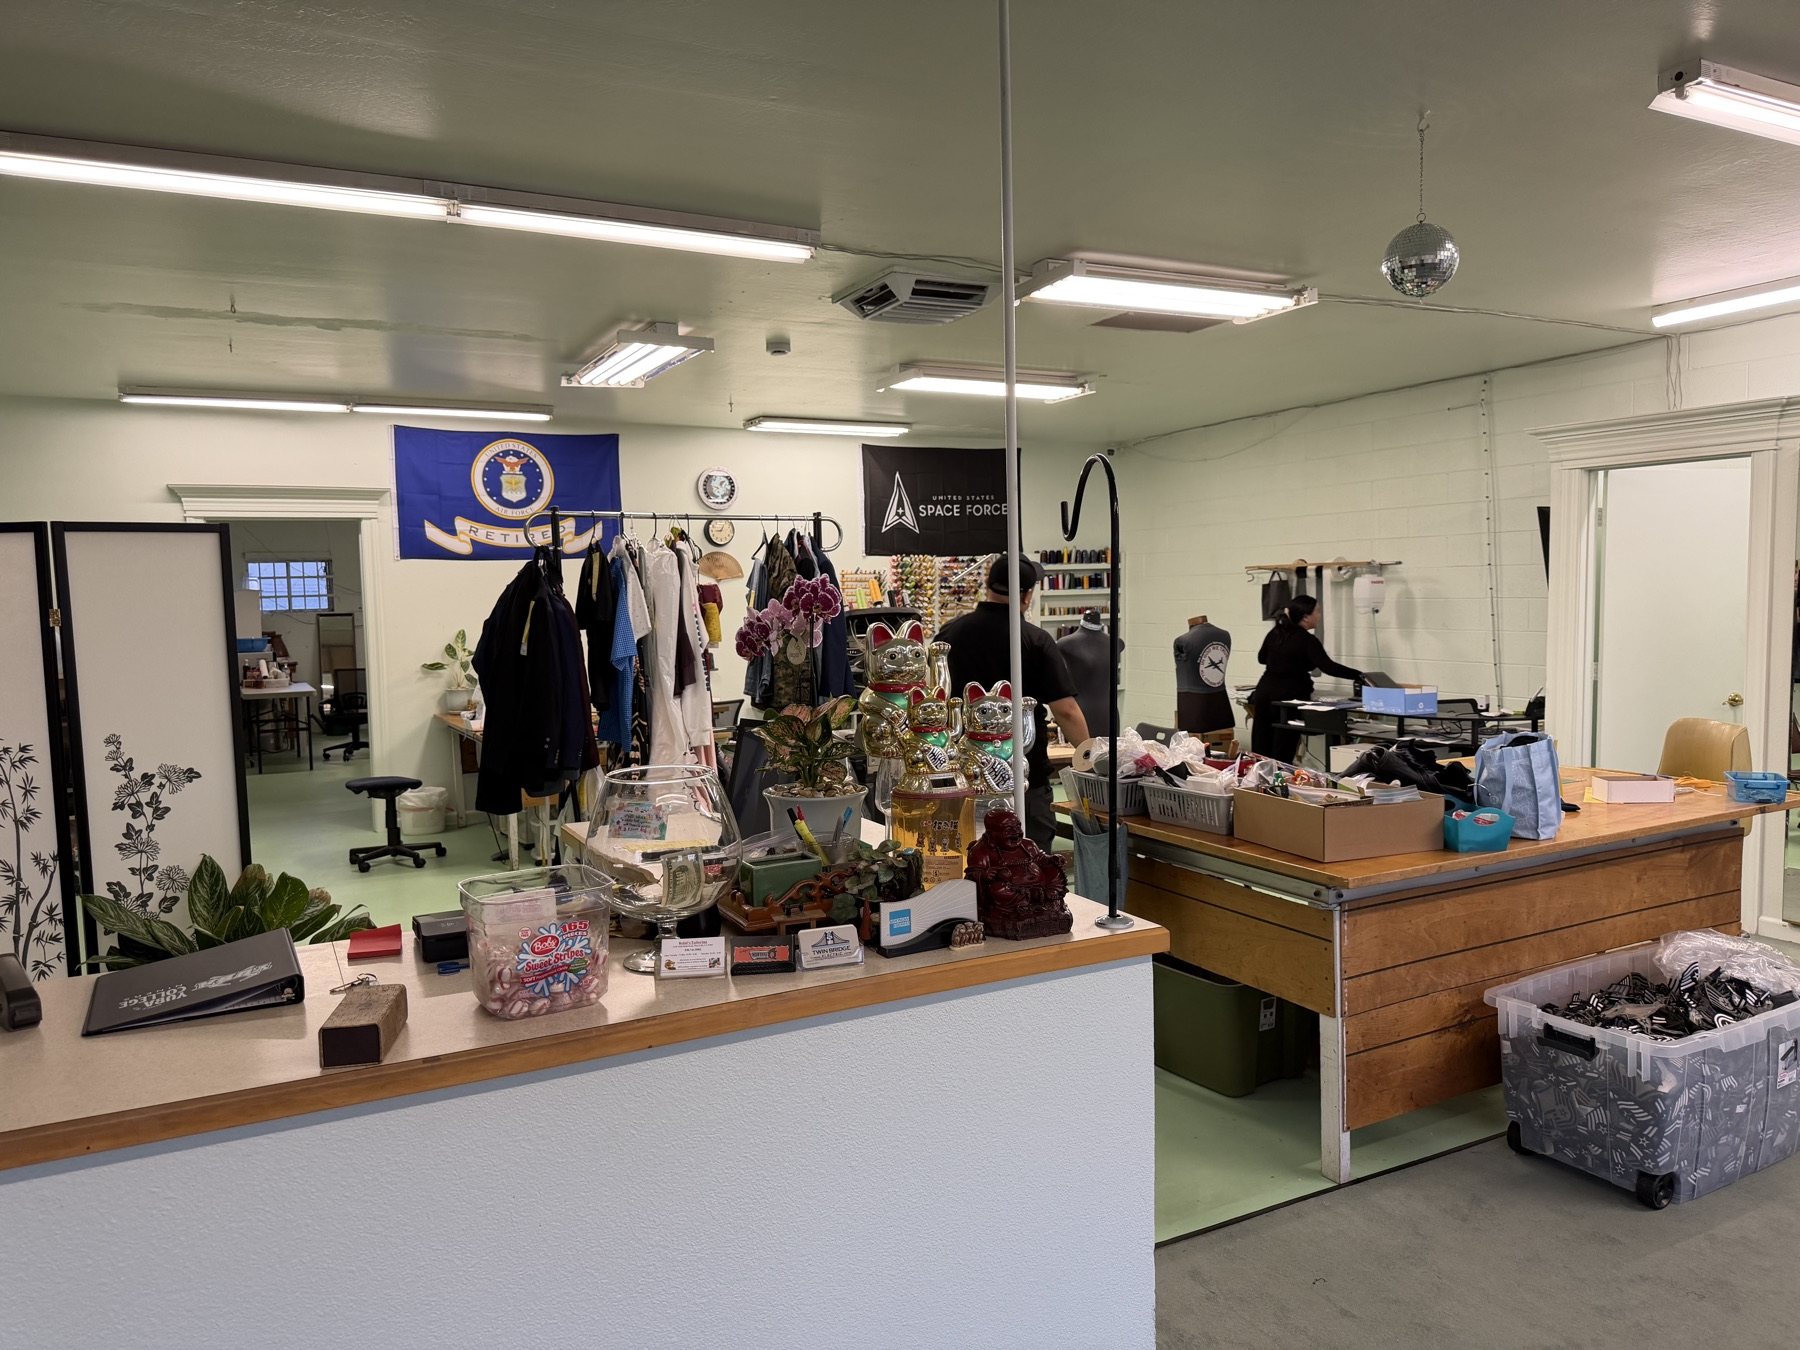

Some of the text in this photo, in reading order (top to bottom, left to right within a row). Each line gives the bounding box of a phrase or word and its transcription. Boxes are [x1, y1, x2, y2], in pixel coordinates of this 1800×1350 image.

[485, 443, 538, 459] UNITED STATES
[496, 506, 534, 516] AIR FORCE
[919, 503, 1008, 516] SPACE FORCE
[561, 920, 589, 932] 165
[812, 945, 852, 956] TWIN BRIDGE
[525, 949, 584, 973] Sweet Stripes
[118, 985, 188, 1009] COLLEGE
[143, 992, 188, 1008] YUBA
